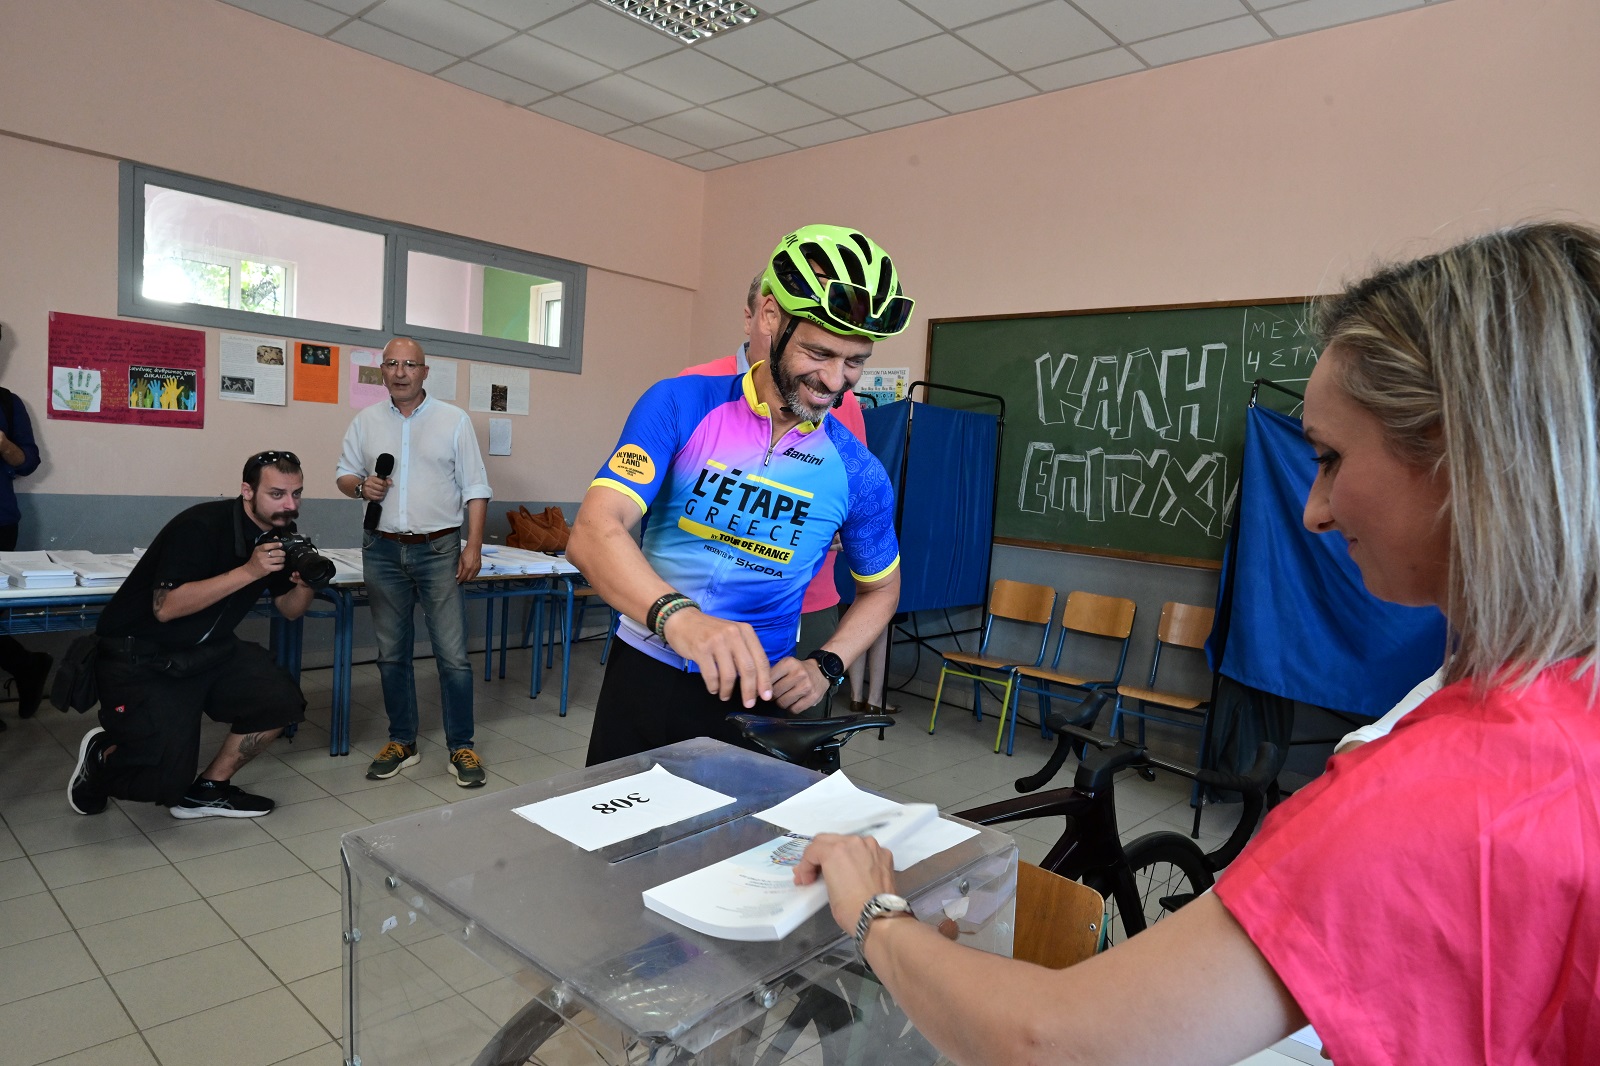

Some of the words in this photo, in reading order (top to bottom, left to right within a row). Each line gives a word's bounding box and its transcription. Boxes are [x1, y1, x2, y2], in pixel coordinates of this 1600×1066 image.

[1247, 350, 1260, 373] 4
[143, 373, 185, 381] ΔΙΚΑΙΩΜΑΤΑ
[1035, 342, 1228, 443] ΚΑΛΗ
[616, 451, 648, 464] OLYMPIAN
[621, 458, 641, 468] LAND
[783, 447, 825, 466] Santini
[684, 498, 803, 547] GREECE
[719, 533, 741, 546] TOUR
[741, 540, 753, 551] DE
[753, 543, 790, 561] FRANCE
[703, 544, 728, 559] PRESENTED
[735, 557, 783, 579] SKODA
[591, 792, 651, 815] 308
